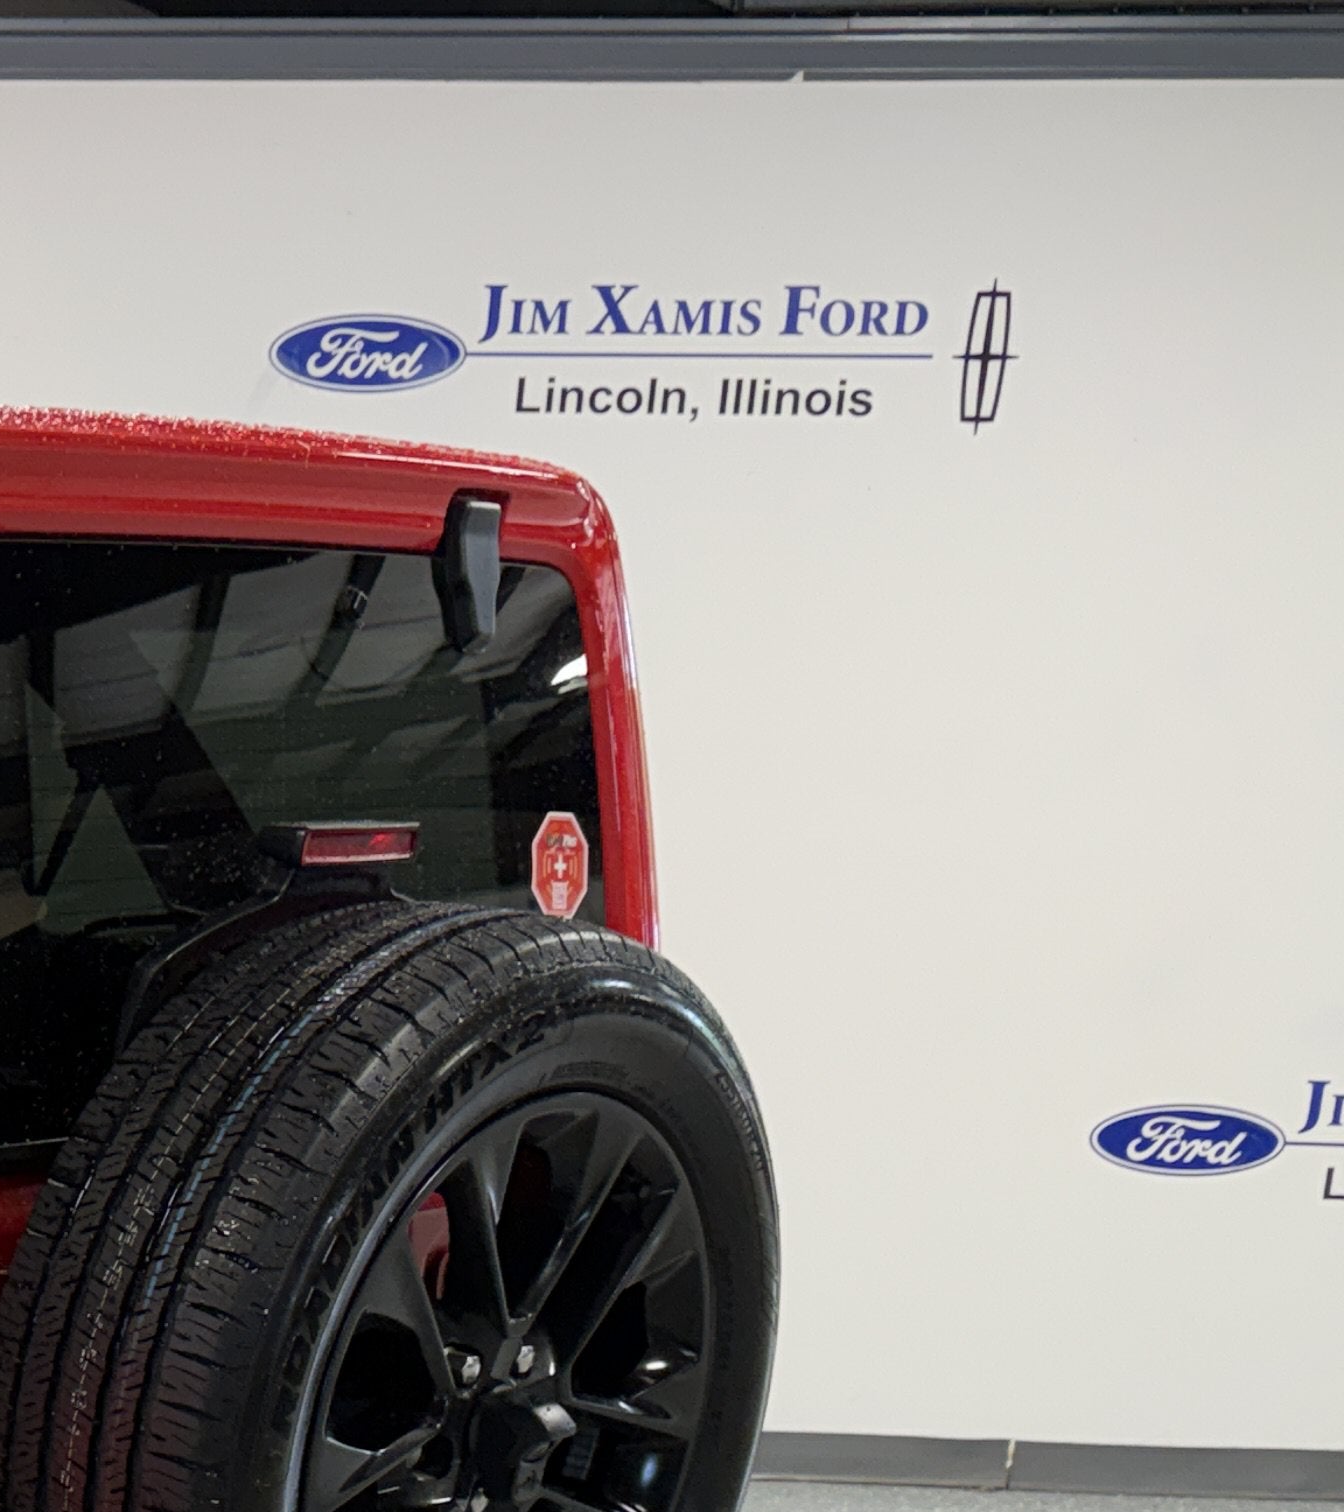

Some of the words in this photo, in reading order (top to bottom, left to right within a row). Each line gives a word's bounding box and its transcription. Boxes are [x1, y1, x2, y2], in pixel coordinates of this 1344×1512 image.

[478, 284, 571, 342] JIM
[584, 284, 763, 337] XAMIS
[777, 285, 930, 339] FORD
[305, 327, 423, 381] Ford
[515, 377, 700, 421] Lincoln,
[718, 380, 874, 417] Illinois
[1126, 1115, 1248, 1166] Ford
